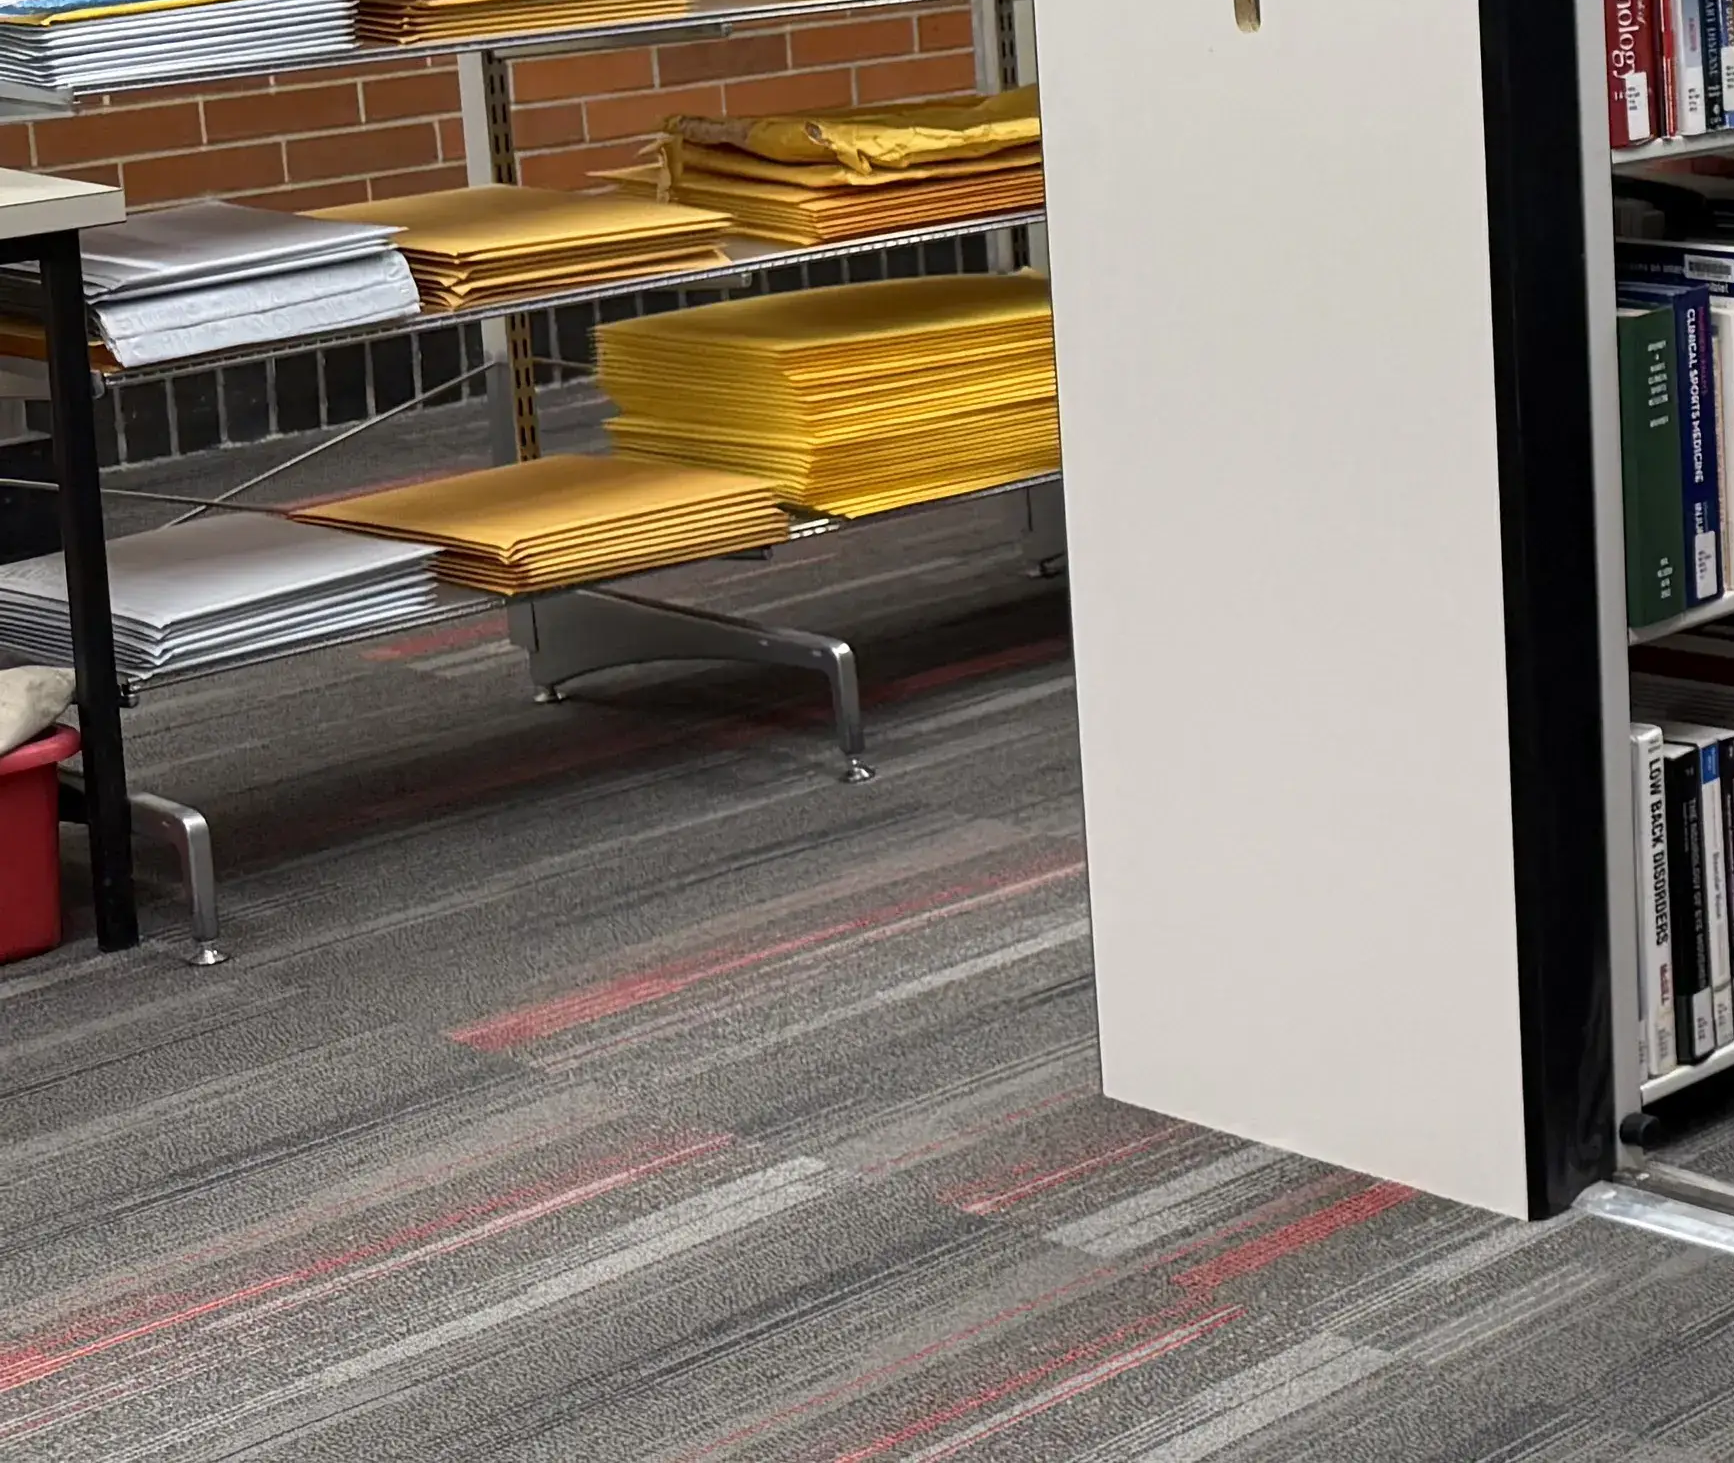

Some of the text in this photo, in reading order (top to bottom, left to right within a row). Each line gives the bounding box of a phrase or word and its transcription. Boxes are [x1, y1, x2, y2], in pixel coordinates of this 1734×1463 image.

[1686, 309, 1704, 483] CLINICAL SPORTS MEDICINE
[1648, 759, 1669, 946] LOW BACK DISORDERS
